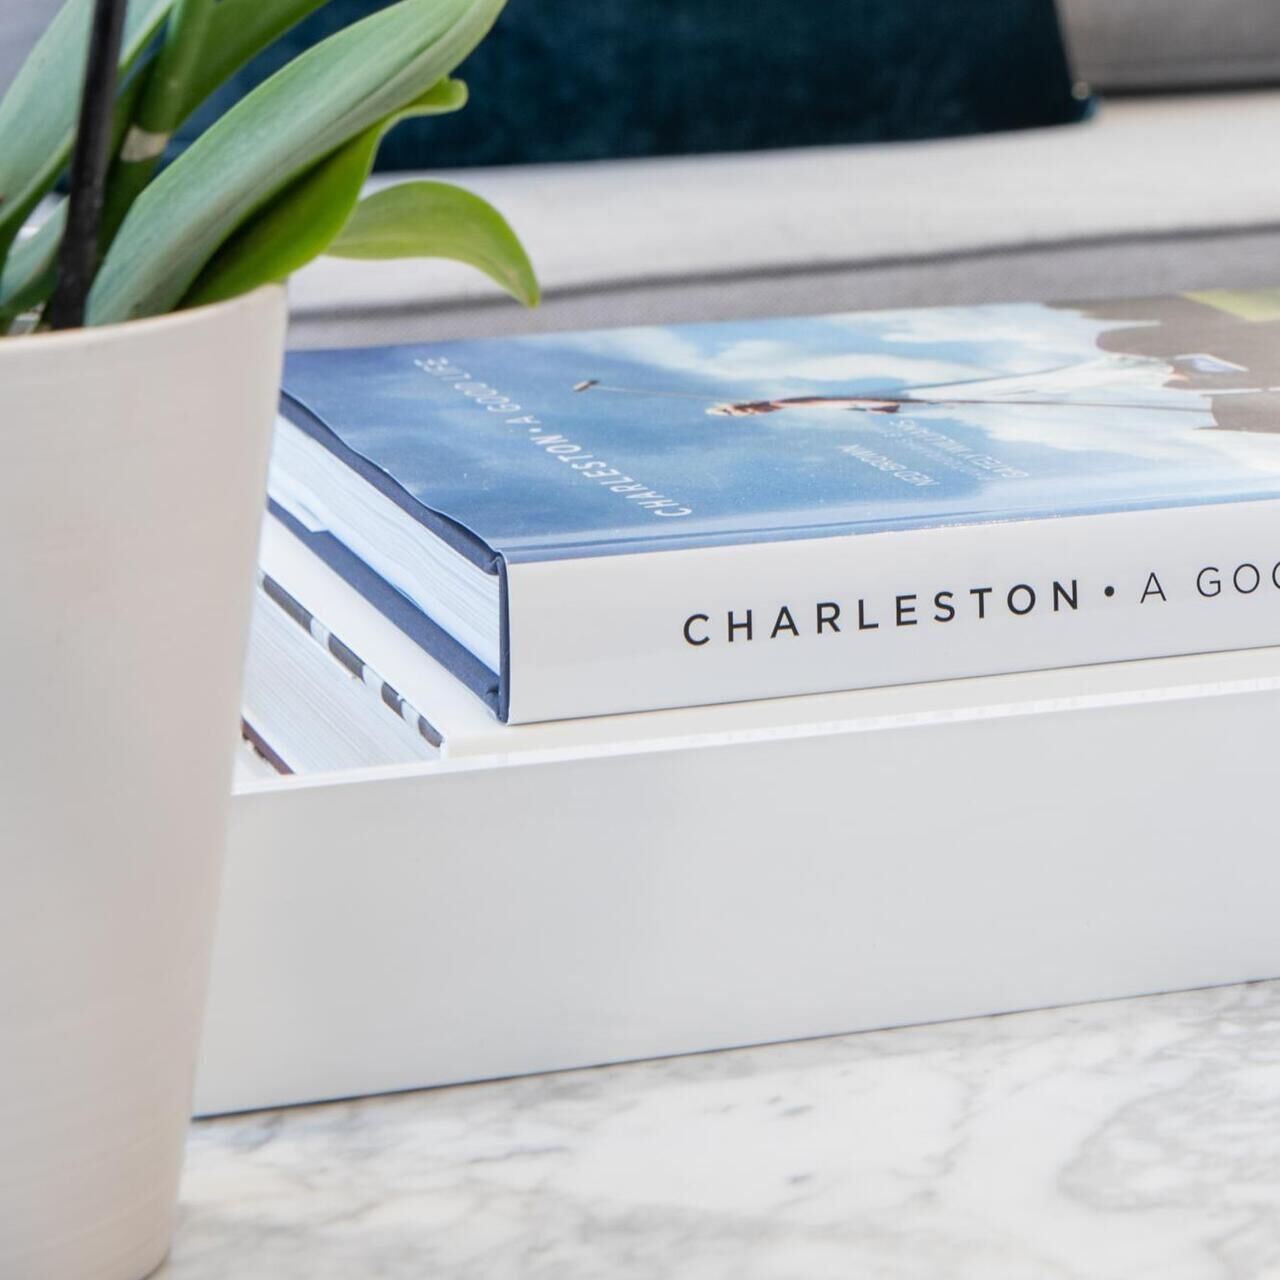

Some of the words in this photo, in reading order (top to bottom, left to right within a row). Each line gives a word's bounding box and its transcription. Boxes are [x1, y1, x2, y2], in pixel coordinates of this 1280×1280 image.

[413, 356, 472, 381] LIFE
[453, 381, 521, 413] GOOD
[505, 414, 542, 424] A
[530, 434, 693, 518] CHARLESTON
[683, 579, 1079, 646] CHARLESTON
[1140, 572, 1167, 604] A
